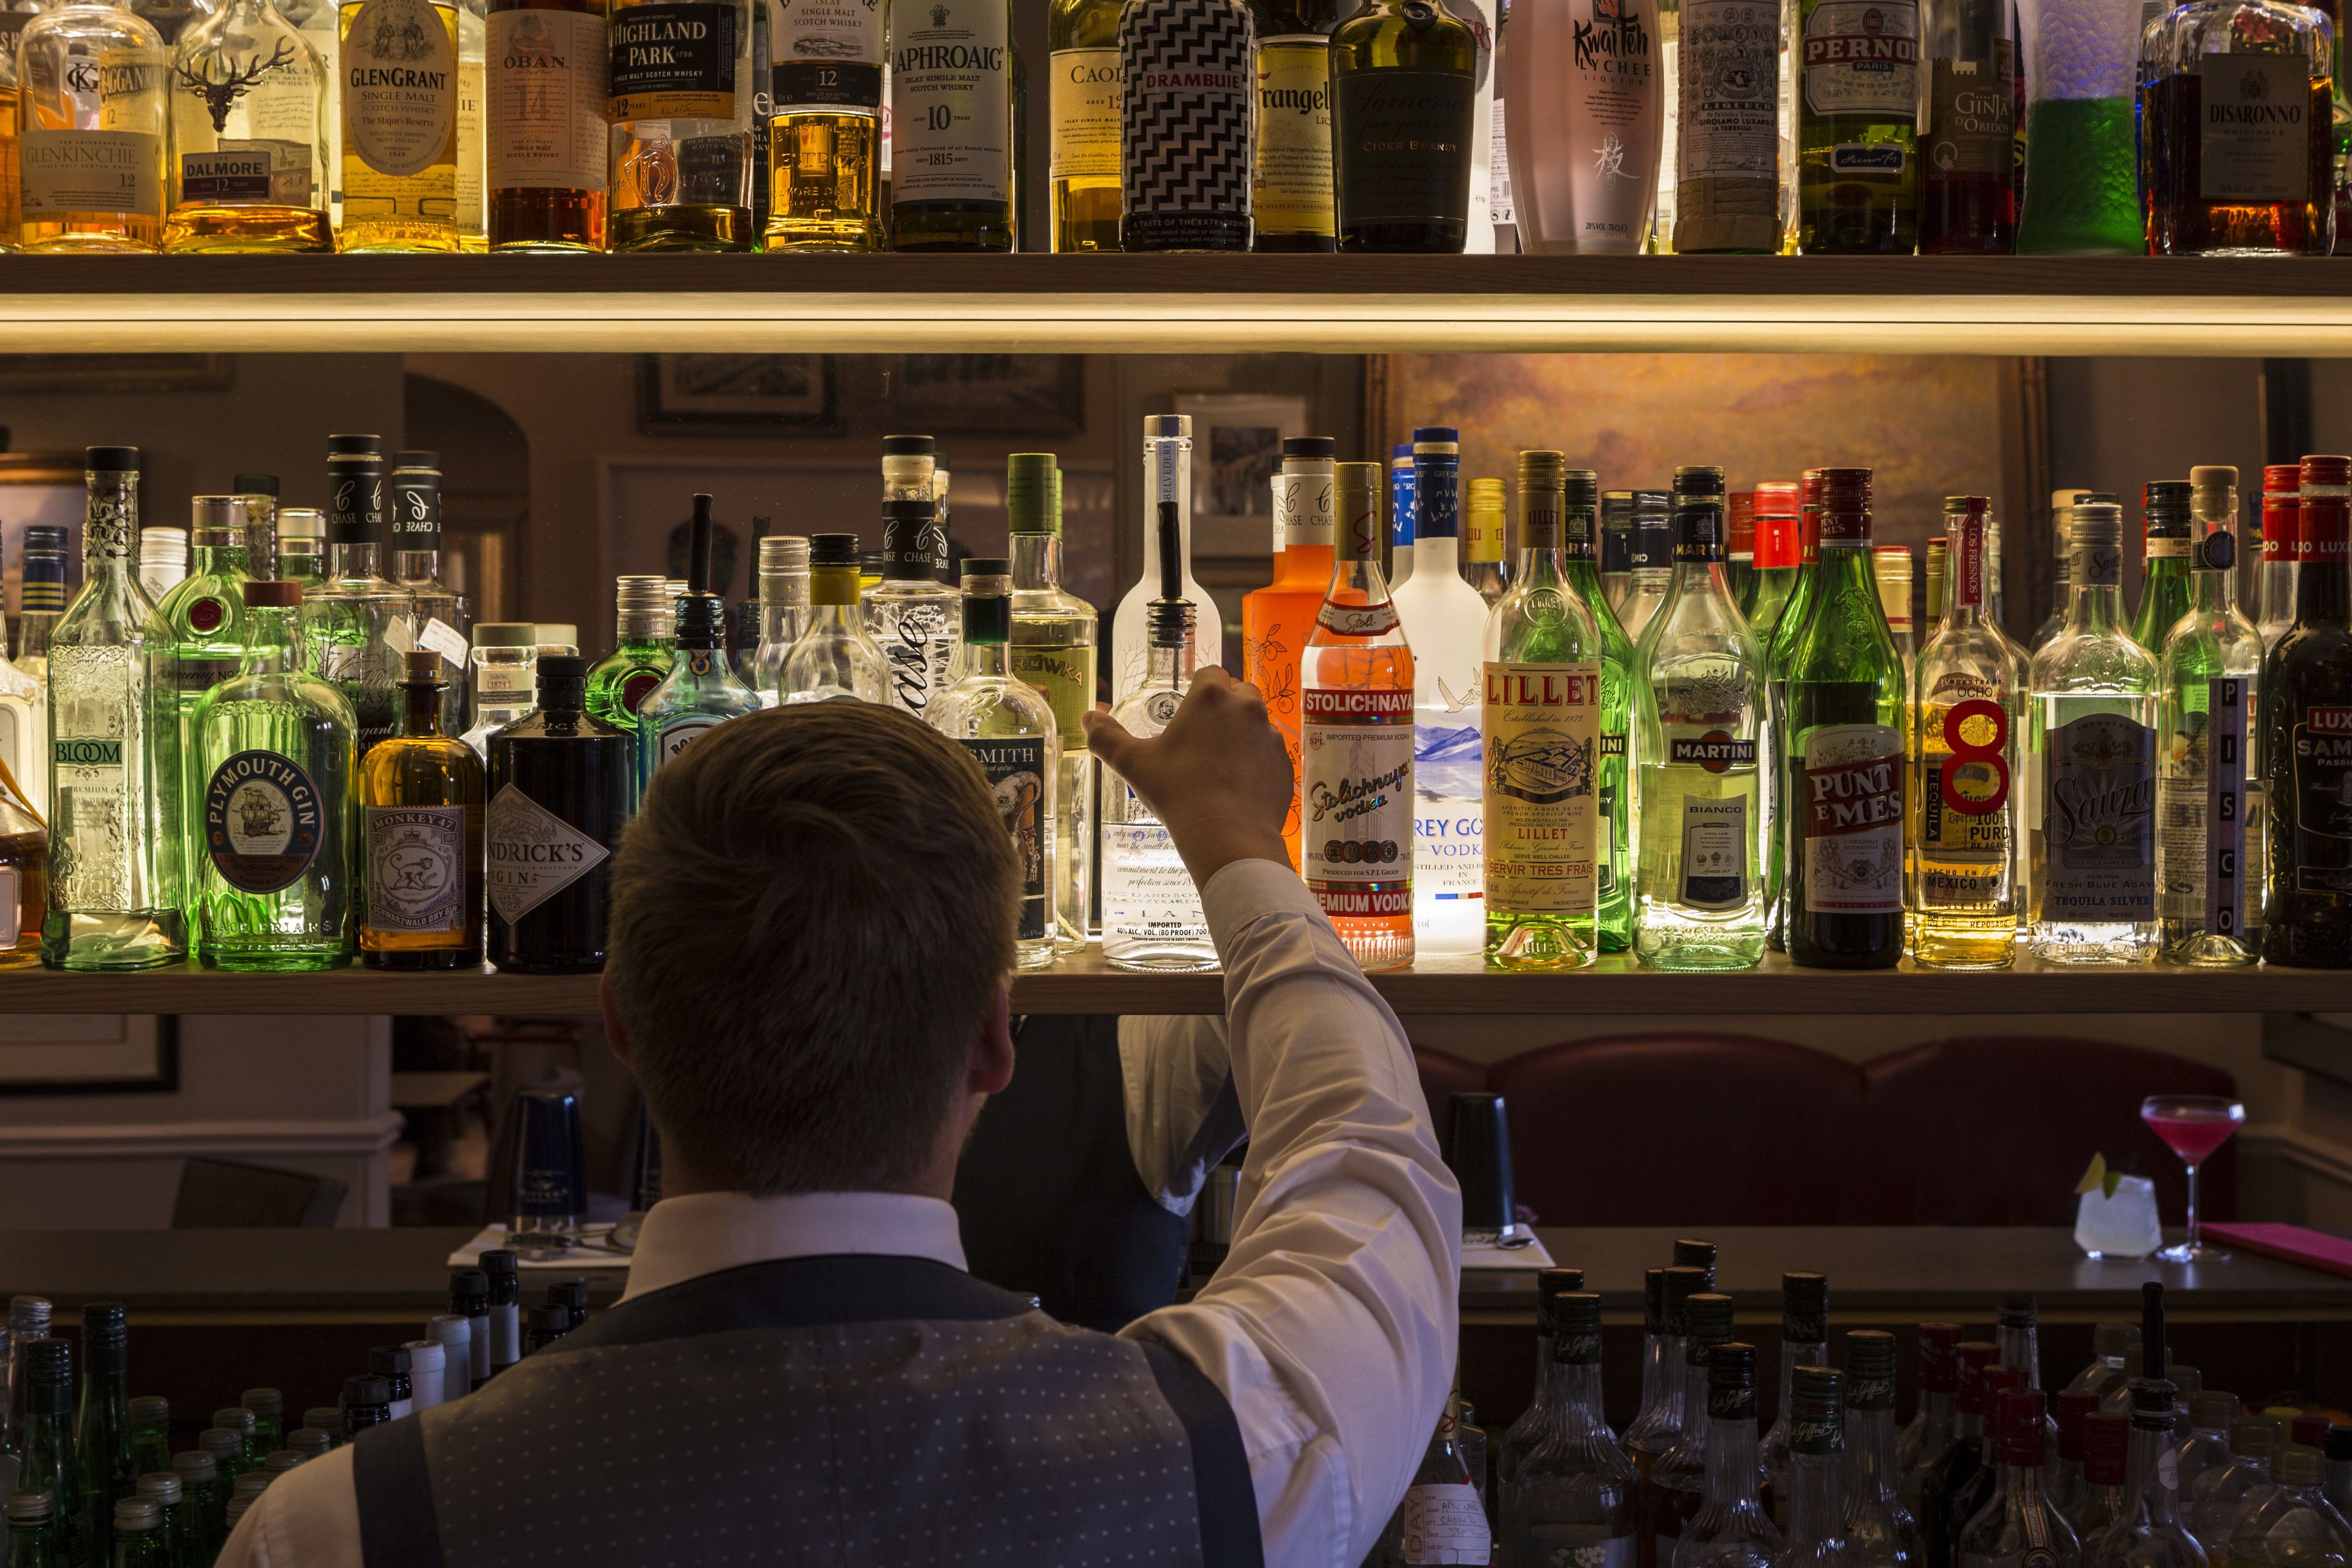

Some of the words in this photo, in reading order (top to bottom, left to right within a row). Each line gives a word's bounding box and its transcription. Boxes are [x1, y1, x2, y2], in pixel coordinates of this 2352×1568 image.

[829, 19, 862, 28] WHISKY
[614, 22, 706, 46] HIGHLAND
[503, 56, 566, 69] OBAN
[629, 46, 676, 67] PARK
[1580, 58, 1651, 77] LYCHEE
[819, 70, 838, 86] 12
[1146, 74, 1240, 89] DRAMBUIE
[1585, 74, 1643, 86] LIQUEUR
[362, 91, 401, 101] SINGLE
[405, 92, 435, 102] MALT
[1258, 72, 1330, 115] rangel
[362, 104, 398, 113] SCOTCH
[401, 105, 435, 115] WHISKY
[617, 98, 629, 118] 12
[1955, 92, 2008, 119] GINJA
[362, 116, 376, 126] The
[405, 118, 434, 127] Reserve
[927, 105, 951, 130] 10
[2210, 104, 2300, 125] DISARONNO
[1363, 142, 1404, 152] CIDER
[1409, 140, 1457, 152] BRANDY
[26, 147, 135, 164] GLENKINCHIE
[929, 154, 953, 165] 1815
[187, 162, 263, 176] DALMORE
[119, 173, 135, 187] 12
[215, 179, 230, 191] 12
[1163, 442, 1172, 501] BELVEDERE
[332, 513, 356, 524] CHASE
[1528, 510, 1560, 526] LILLET
[1969, 524, 1978, 547] LOS
[904, 551, 930, 563] CHASE
[1969, 548, 1978, 594] FRESNOS
[1344, 612, 1374, 634] Stoli
[894, 615, 927, 717] ase
[1012, 654, 1083, 687] RÓWKA
[1487, 674, 1597, 706] LILLET
[1958, 687, 1993, 698] OCHO
[1306, 693, 1413, 712] STOLICHNAYA
[1503, 709, 1551, 723] Established
[55, 743, 121, 763] BLOOM
[969, 748, 1035, 763] SMITH
[1676, 744, 1752, 758] MARTINI
[1942, 699, 2009, 816] 8
[1809, 762, 1893, 802] PUNT
[209, 758, 296, 824] PLYMOUTH
[292, 786, 315, 824] GIN
[1815, 805, 1830, 821] E
[1834, 790, 1902, 827] MES
[1929, 772, 1939, 837] TEQUILA
[2043, 774, 2154, 848] Sauza
[374, 813, 437, 829] MONKEY
[438, 819, 454, 828] 47
[1975, 810, 2005, 826] 100%
[1414, 819, 1449, 838] REY
[1518, 828, 1568, 840] LILLET
[1970, 826, 2008, 840] PURO
[489, 842, 582, 862] NDRICK'S
[1565, 841, 1585, 850] France
[1117, 865, 1159, 875] commitment
[1490, 862, 1525, 875] SERVIR
[1529, 865, 1563, 876] TRES
[1567, 864, 1593, 875] FRAIS
[497, 871, 529, 884] GIN
[1128, 878, 1161, 888] perfection
[1928, 876, 1977, 890] MEXICO
[1553, 883, 1580, 895] France
[1314, 892, 1369, 912] EMIUM
[1928, 901, 1965, 910] SINGLE
[2054, 896, 2106, 907] TEQUILA
[2110, 896, 2152, 907] SILVER
[373, 903, 427, 926] SCHWARZWALD
[428, 911, 447, 922] DRY
[445, 905, 458, 914] GIN
[1970, 920, 2007, 929] REPOSADO
[1410, 1497, 1422, 1553] DAY
